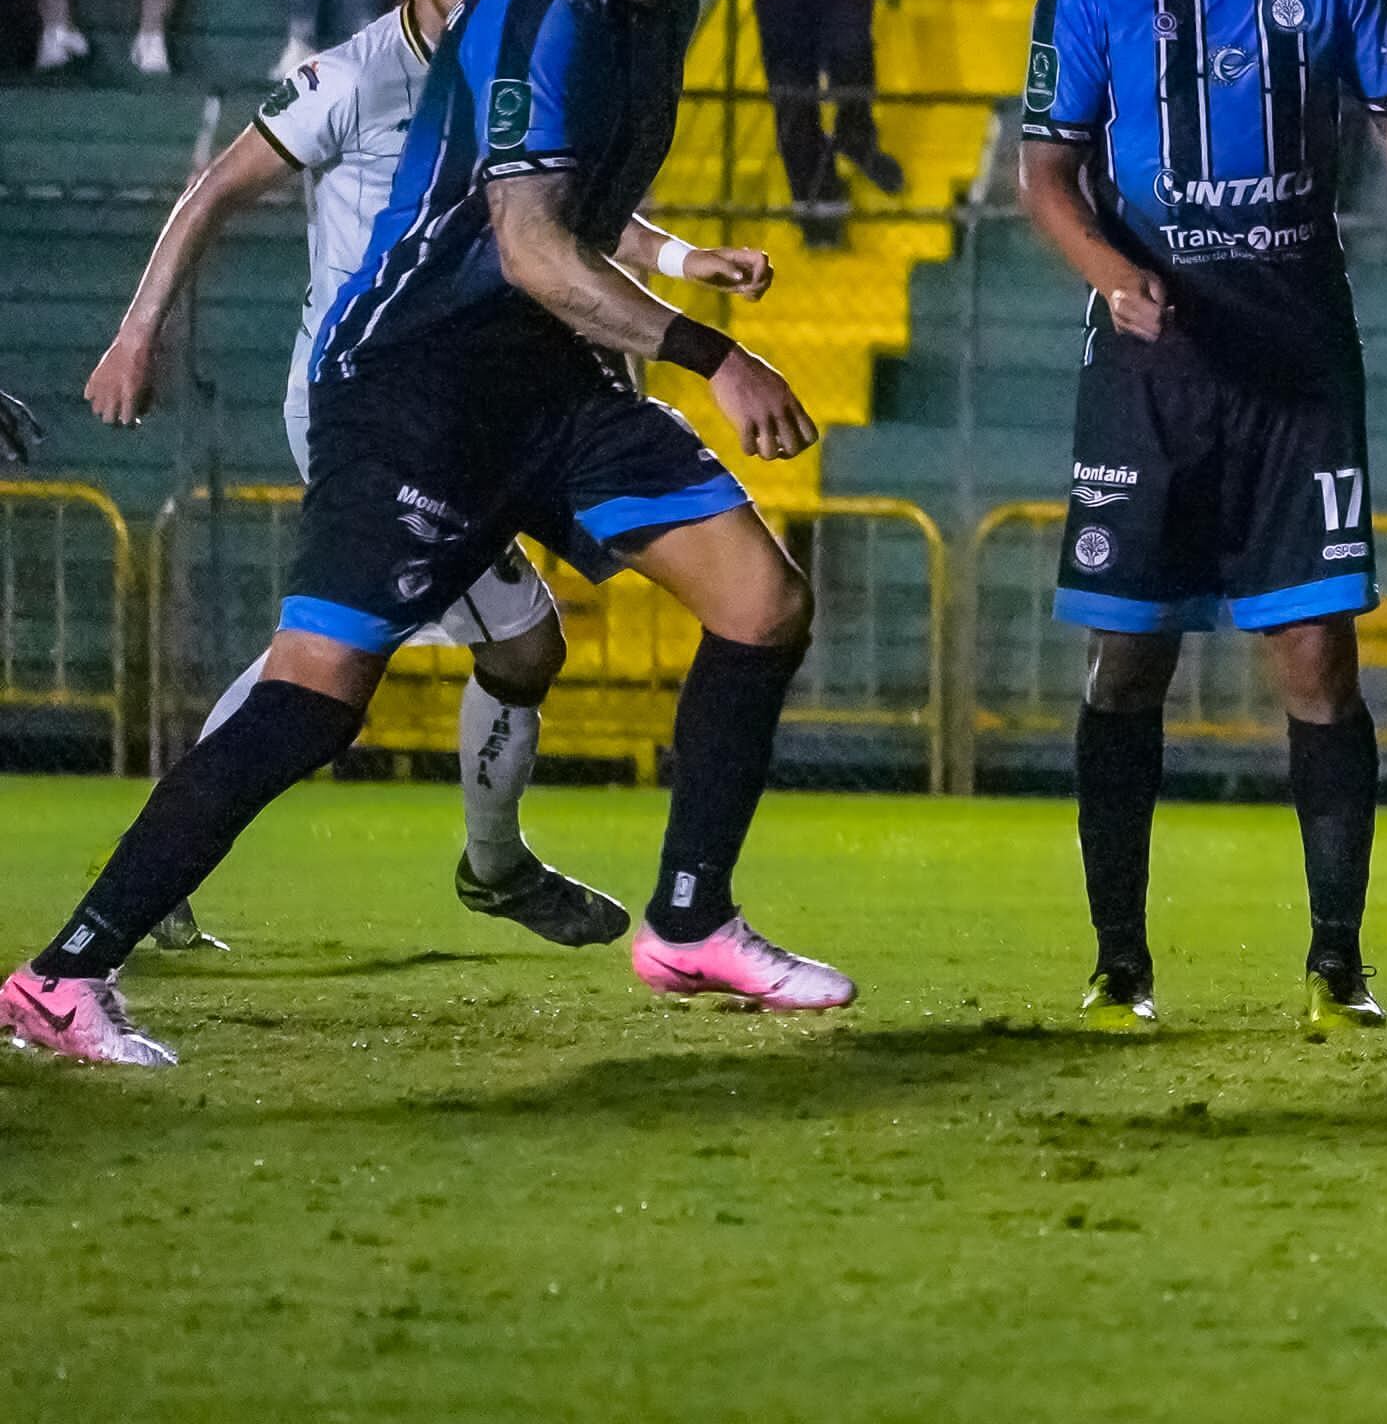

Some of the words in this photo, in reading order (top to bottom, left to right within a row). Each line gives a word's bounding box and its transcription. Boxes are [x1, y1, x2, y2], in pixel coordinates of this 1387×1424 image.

[396, 484, 448, 518] Mont
[1313, 467, 1364, 531] 17
[477, 706, 512, 789] IBERIA
